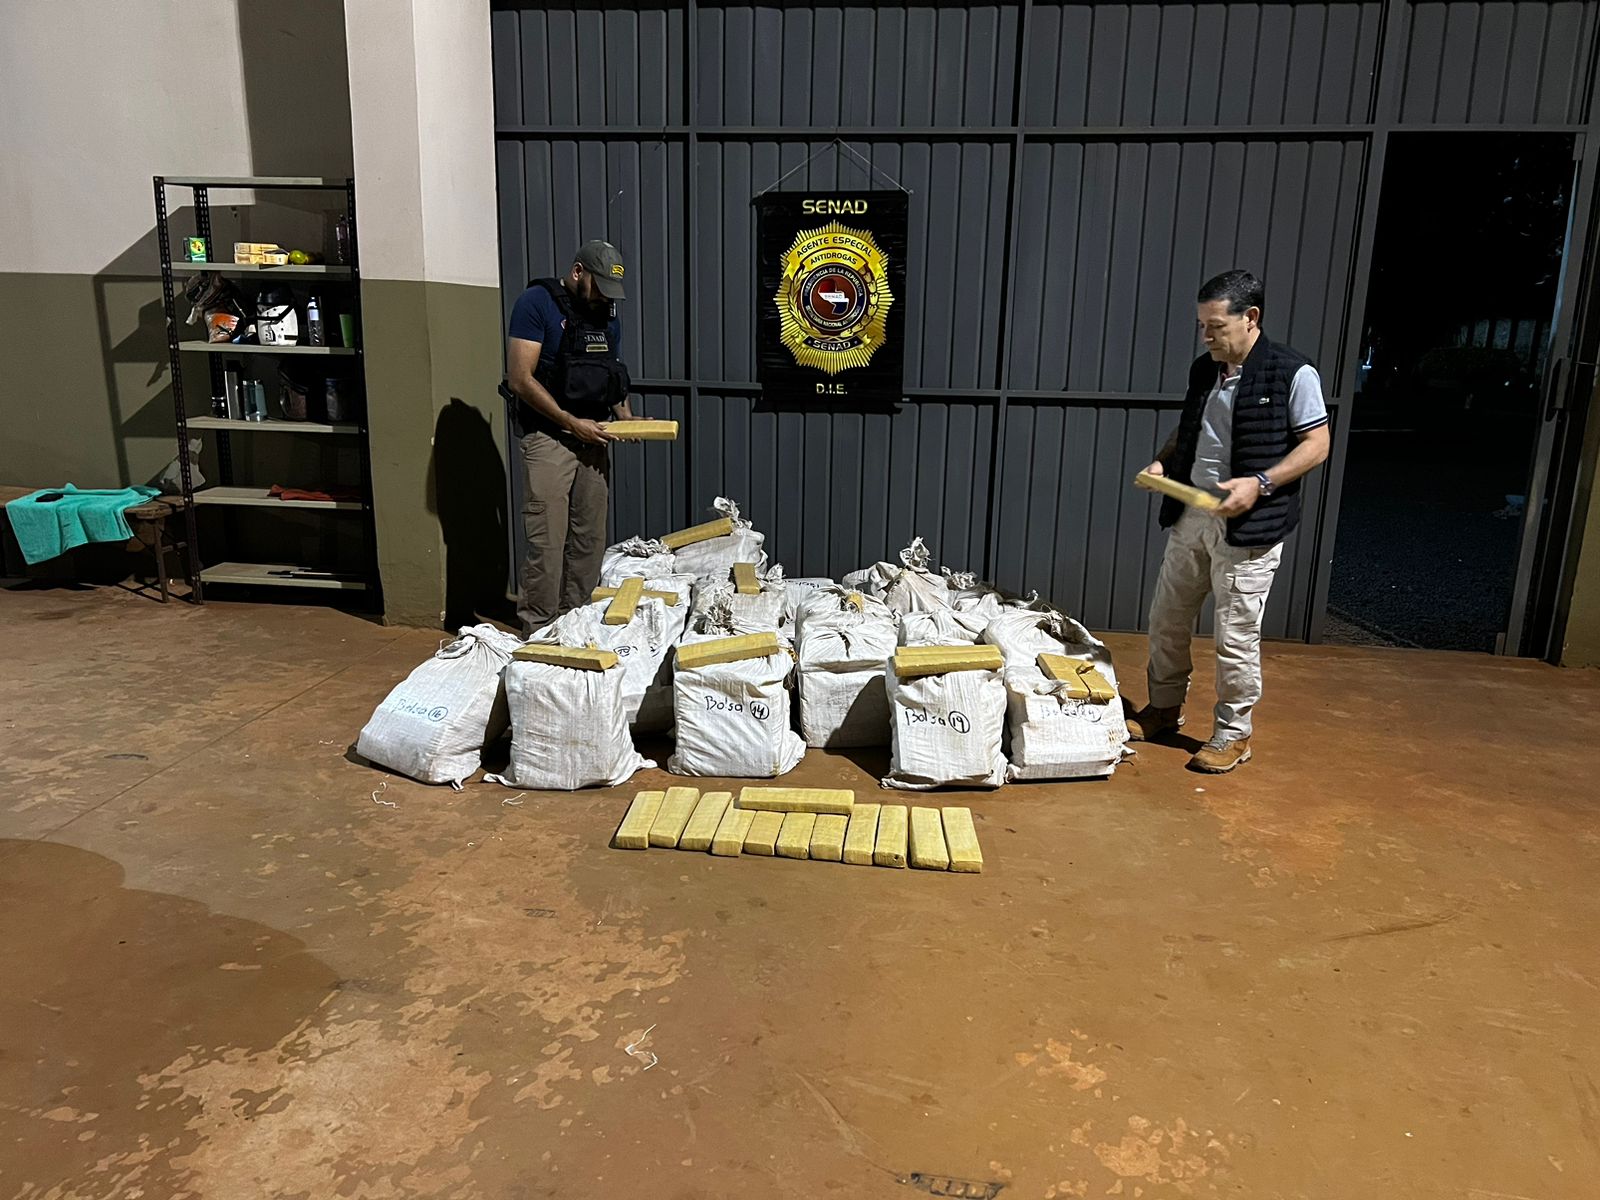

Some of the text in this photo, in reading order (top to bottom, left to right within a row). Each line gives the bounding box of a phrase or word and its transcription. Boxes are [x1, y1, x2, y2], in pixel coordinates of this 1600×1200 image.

[802, 199, 868, 214] SENAD
[796, 236, 872, 258] AGENTE ESPECIAL
[810, 252, 858, 265] ANTIDROGAS
[812, 340, 851, 351] SENAD
[816, 383, 848, 395] D.I.E.
[951, 714, 966, 733] 19
